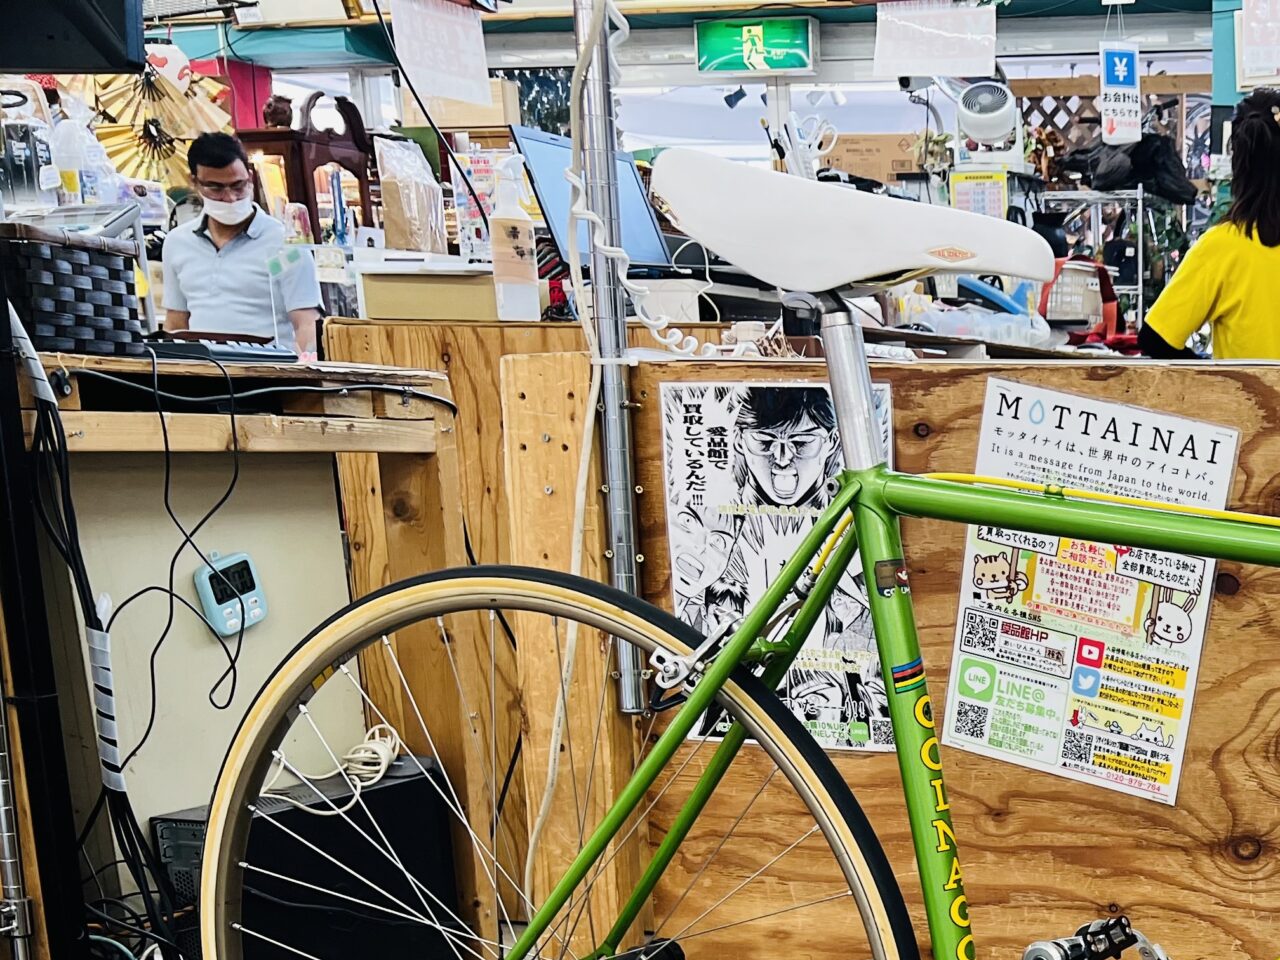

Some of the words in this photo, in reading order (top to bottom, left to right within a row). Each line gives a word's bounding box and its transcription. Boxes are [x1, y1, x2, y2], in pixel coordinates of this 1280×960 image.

[1103, 92, 1138, 103] お会計は
[1104, 108, 1138, 117] こちらです
[706, 426, 729, 470] 愛品館で
[994, 427, 1214, 486] モッタイナイは、世界中のアイコトバ。
[991, 443, 1001, 454] It
[1005, 446, 1014, 457] is
[1018, 451, 1024, 459] a
[1028, 453, 1074, 470] message
[1078, 463, 1103, 477] from
[1107, 469, 1137, 485] Japan
[1142, 479, 1152, 489] to
[1157, 482, 1173, 493] the
[1178, 488, 1212, 502] world.
[1061, 549, 1111, 568] ご相談下さい
[1071, 541, 1106, 557] お気軽に
[1128, 548, 1197, 573] お店で売っている物は
[1001, 621, 1049, 642] 愛品館HP
[968, 673, 987, 685] LINE
[997, 679, 1045, 703] LINE@
